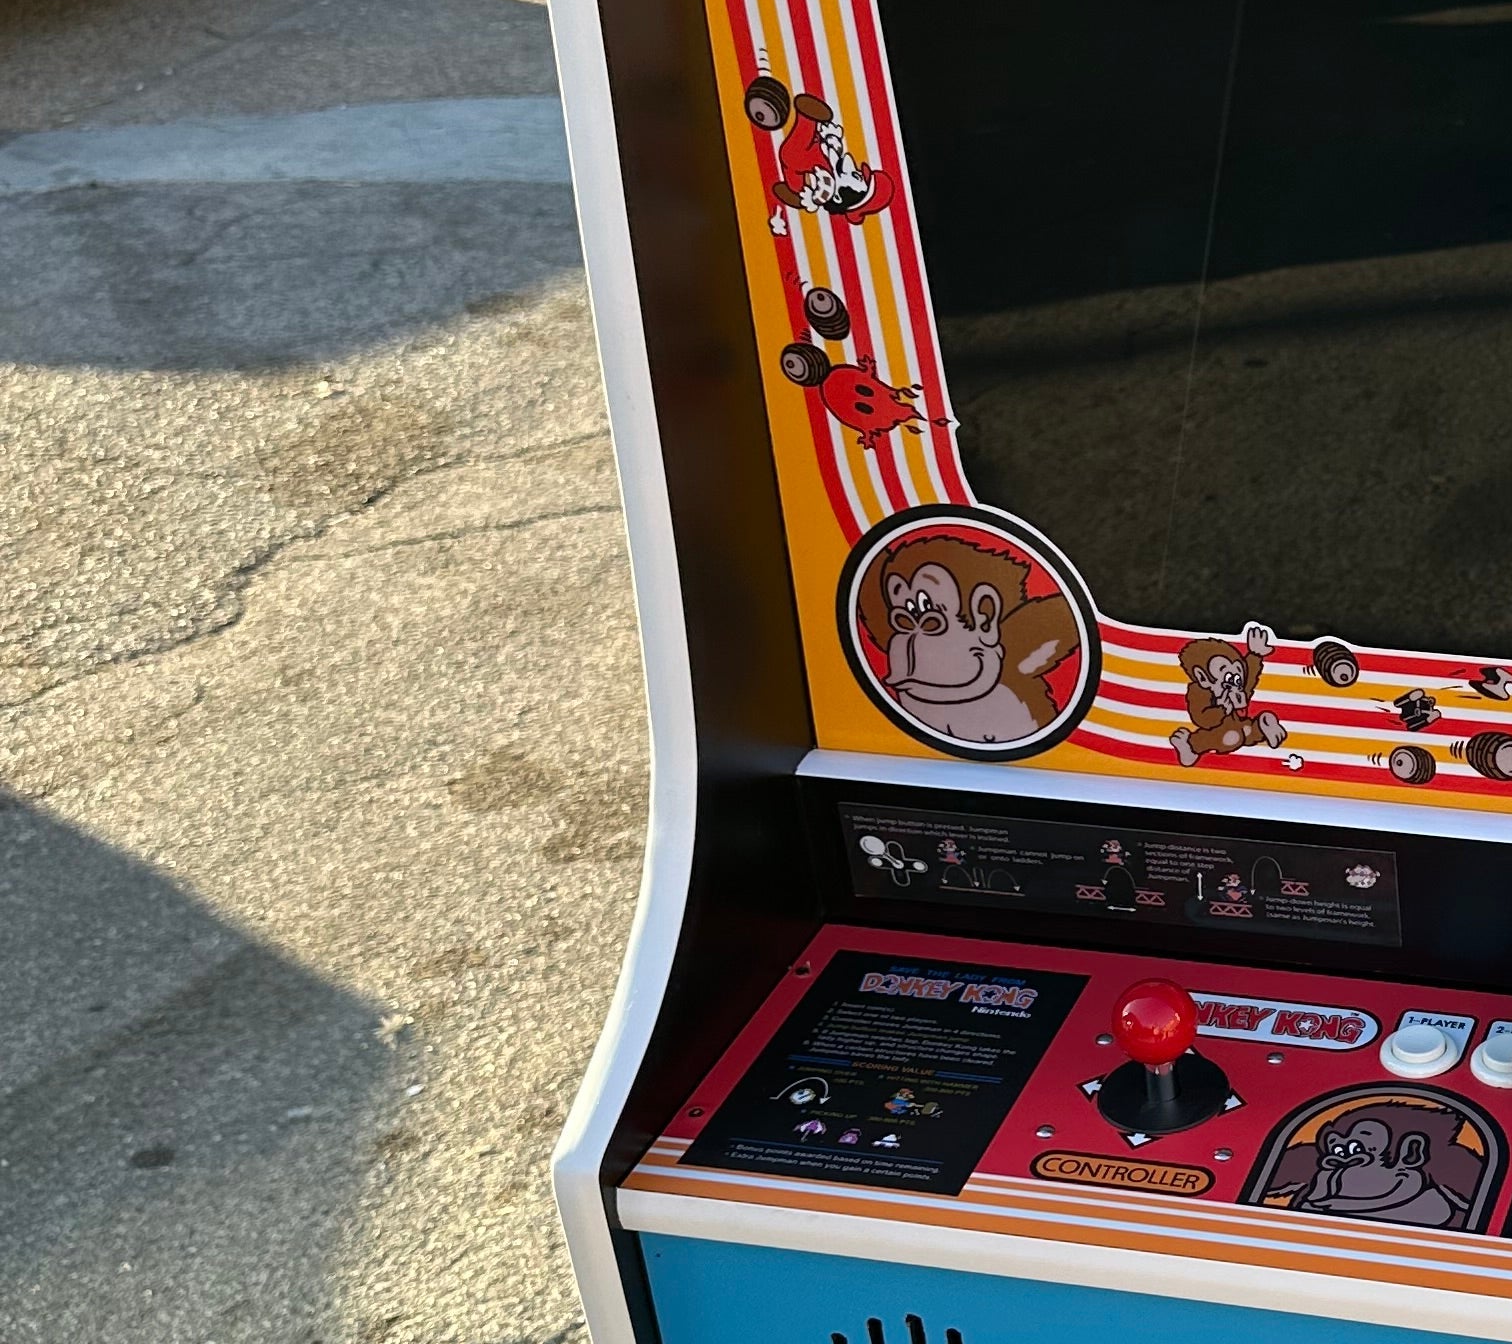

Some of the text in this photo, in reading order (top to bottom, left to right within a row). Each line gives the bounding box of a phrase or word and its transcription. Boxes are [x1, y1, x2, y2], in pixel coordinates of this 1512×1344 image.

[859, 972, 1039, 1010] DONKEY KONG
[970, 1005, 1032, 1019] Nintendo
[1195, 1000, 1366, 1044] NKEY KONG
[850, 1060, 936, 1077] SCORING VALUE
[736, 1143, 765, 1153] Bonus
[1041, 1156, 1202, 1191] CONTROLLER
